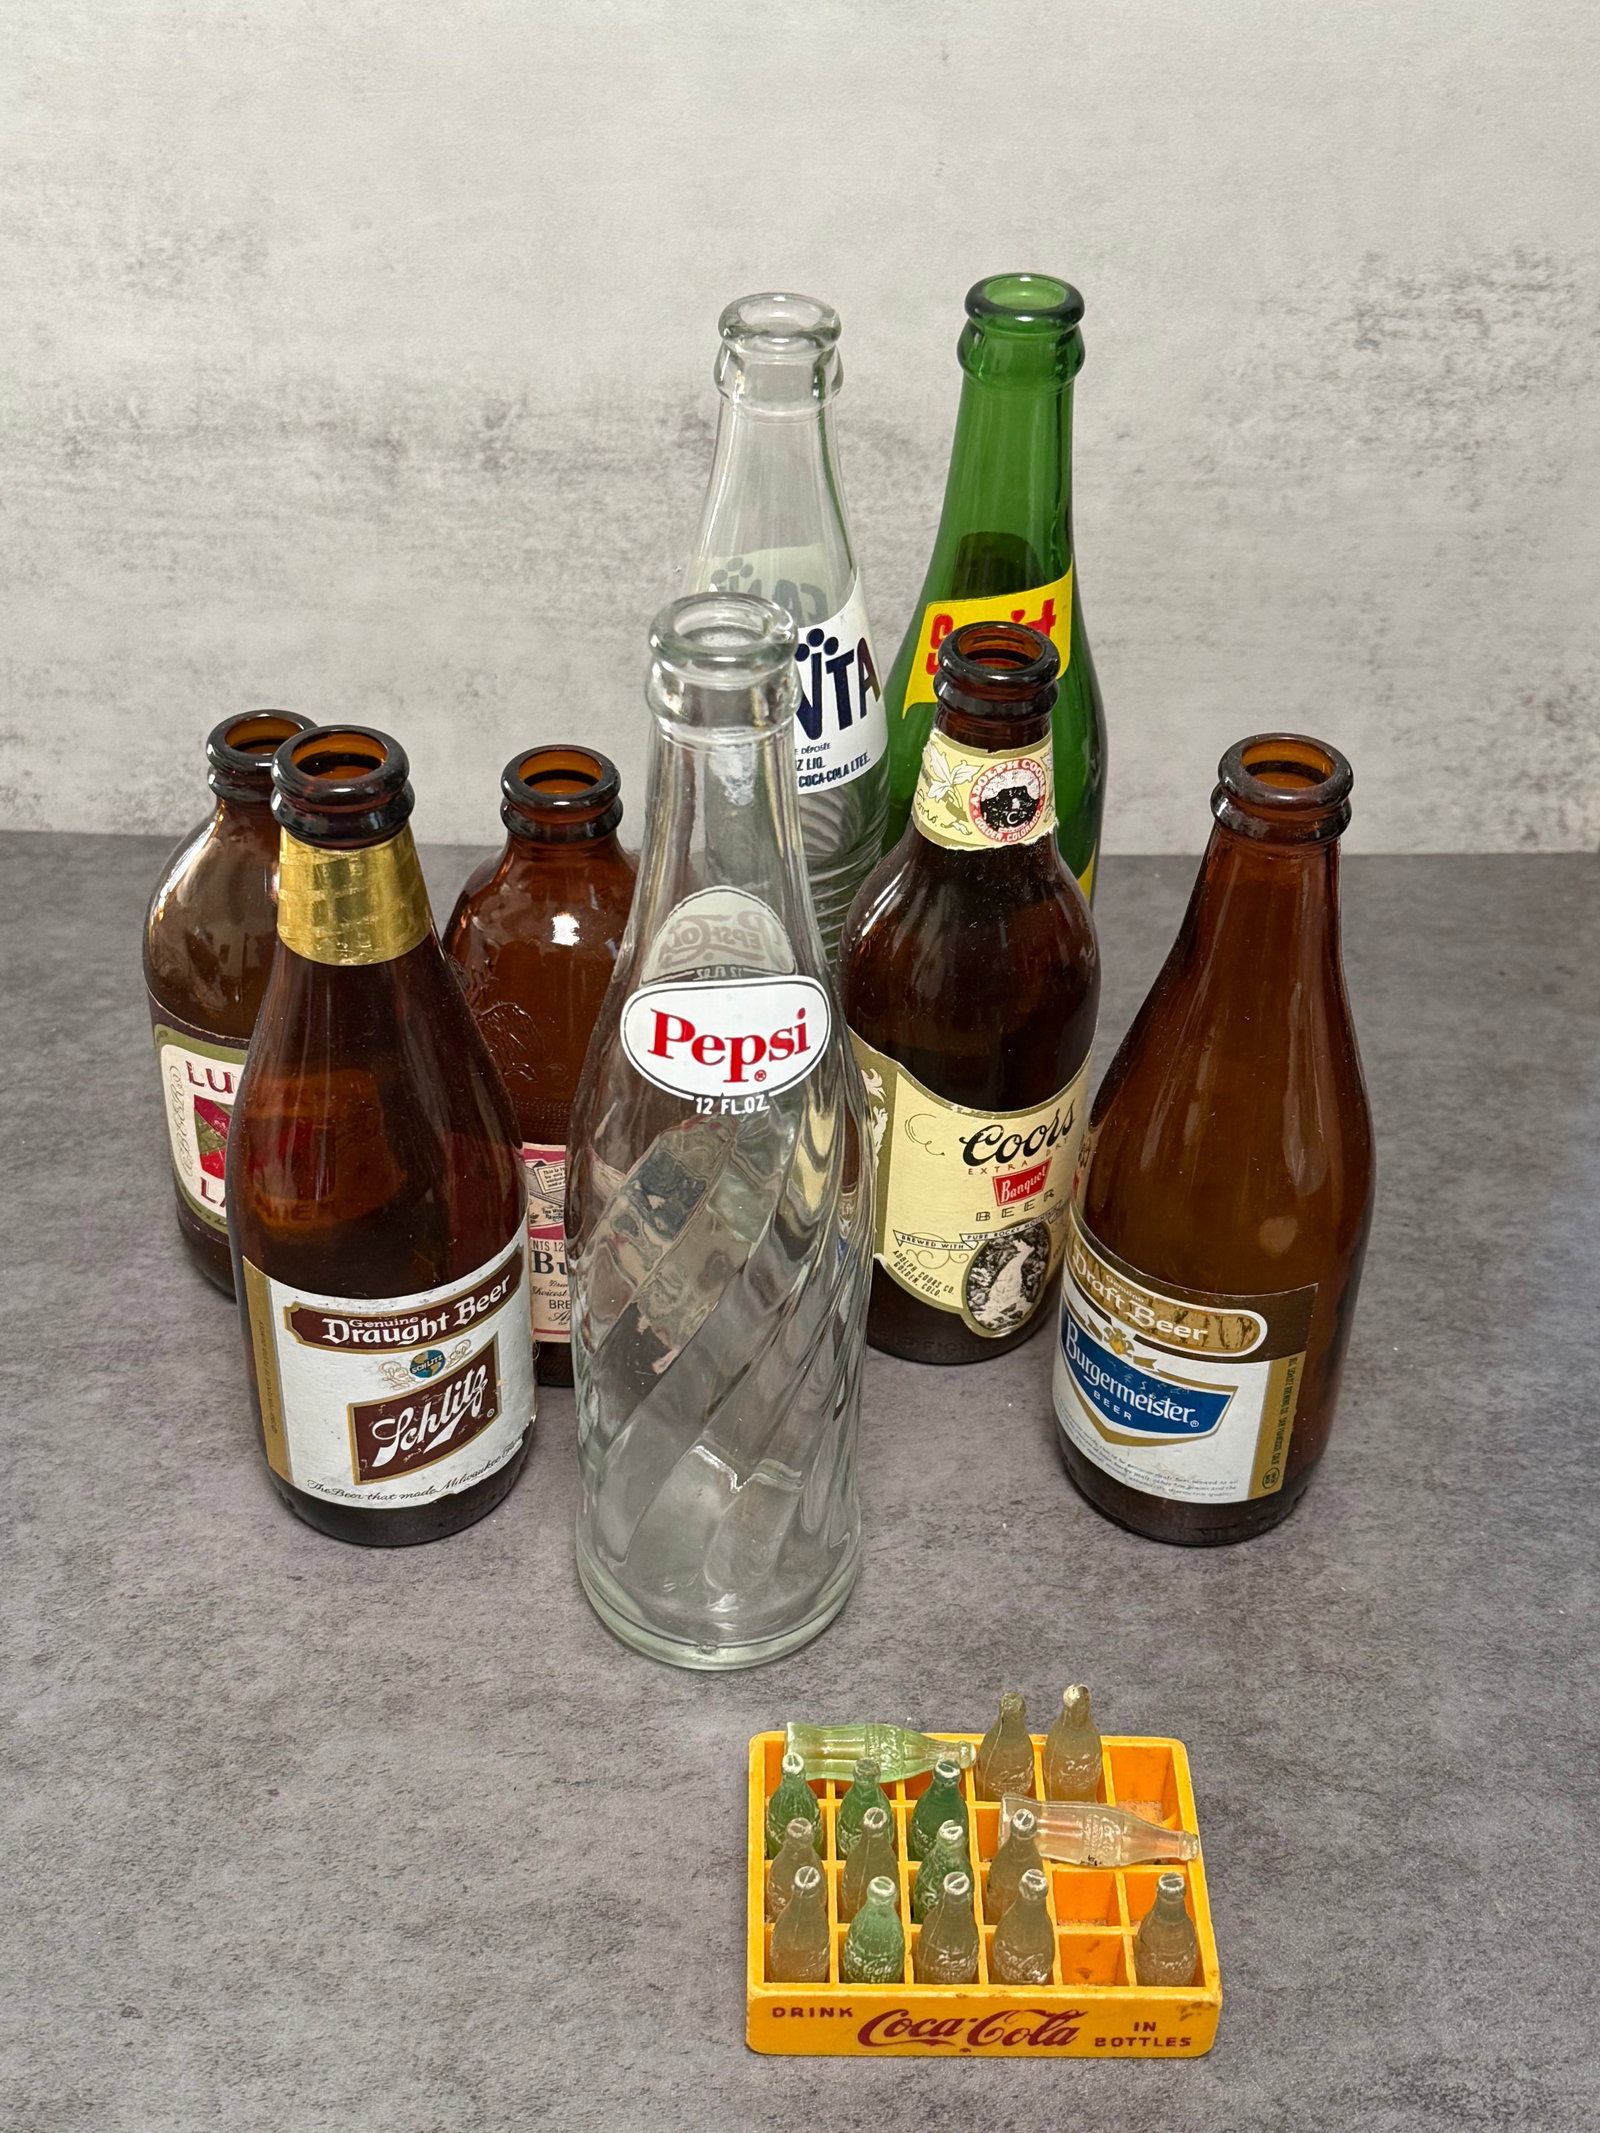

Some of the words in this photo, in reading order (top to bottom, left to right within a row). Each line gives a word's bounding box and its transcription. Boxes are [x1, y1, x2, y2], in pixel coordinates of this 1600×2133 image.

[796, 637, 881, 741] NTA
[799, 764, 850, 788] COCA-COLA
[970, 759, 1020, 808] ADOLPH
[1006, 810, 1041, 842] COLORADO
[647, 1007, 811, 1083] Pepsi
[695, 1097, 713, 1115] 12
[958, 1098, 1076, 1167] Coors
[967, 1159, 1028, 1175] EXTRA
[1001, 1165, 1048, 1201] Banquet
[975, 1189, 1055, 1222] BEER
[901, 1234, 937, 1247] BREWED
[941, 1242, 965, 1250] WITH
[993, 1227, 1020, 1238] ROCKY
[892, 1250, 917, 1273] ADOLPH
[917, 1270, 942, 1289] COORS
[942, 1285, 955, 1296] CO.
[1105, 1274, 1146, 1303] Genuine
[549, 1299, 572, 1310] BRE
[921, 1283, 941, 1299] COLO.
[1072, 1244, 1126, 1309] Draft
[1123, 1300, 1209, 1341] Beer
[321, 1312, 451, 1345] Draught
[453, 1274, 511, 1327] Beer
[349, 1315, 419, 1329] Genuine
[411, 1354, 445, 1375] SCHLITZ
[1066, 1313, 1196, 1424] Burgermeister
[371, 1364, 488, 1468] Schlitz
[1093, 1389, 1133, 1422] BEER
[307, 1479, 332, 1495] The
[328, 1488, 363, 1500] Beer
[363, 1491, 398, 1501] that
[399, 1488, 437, 1500] made
[434, 1456, 501, 1494] Milwaukee
[772, 2006, 854, 2019] DRINK
[857, 2009, 1088, 2049] Coca-Cola
[1132, 2021, 1157, 2033] IN
[1094, 2036, 1193, 2048] BOTTLES
